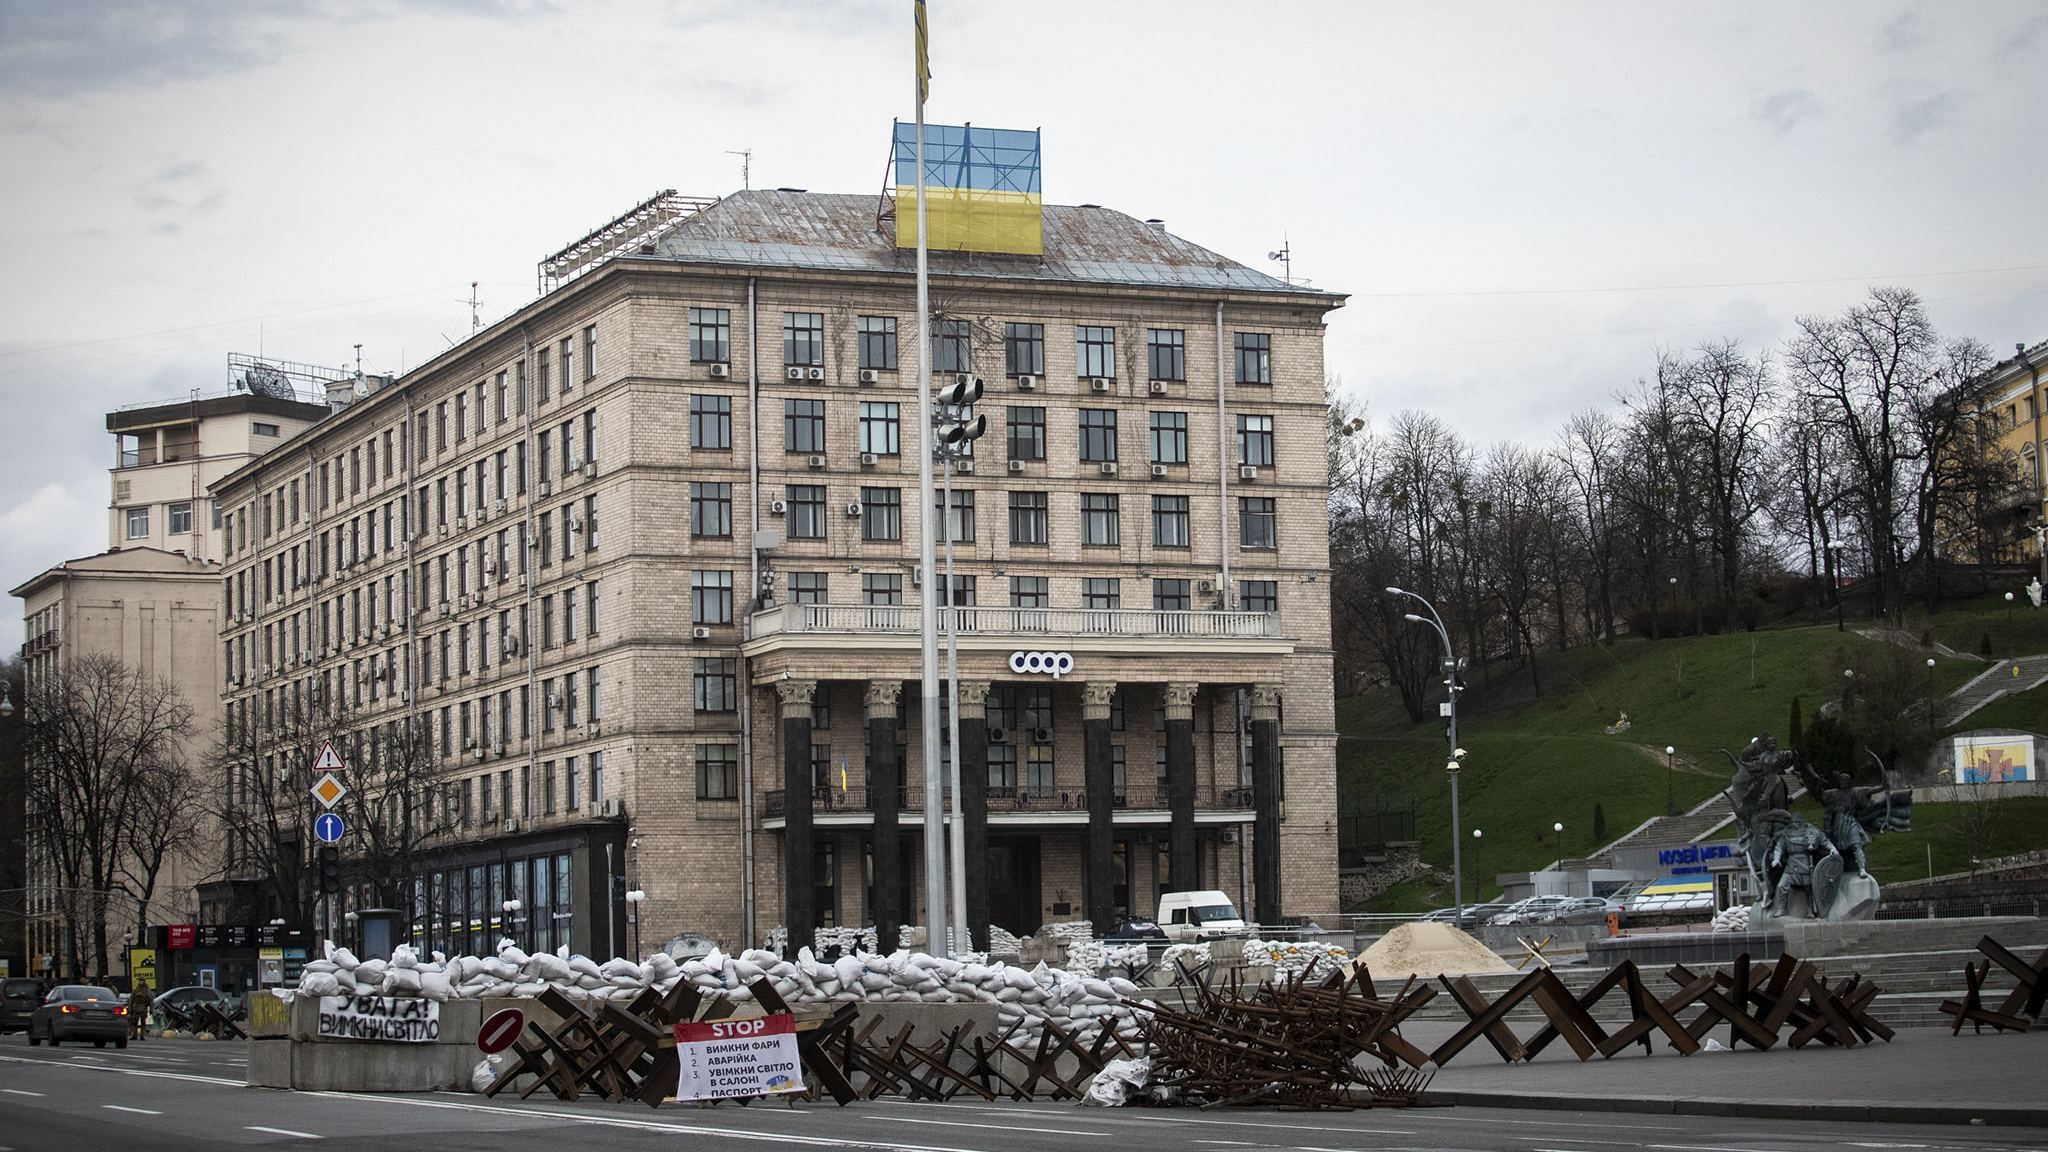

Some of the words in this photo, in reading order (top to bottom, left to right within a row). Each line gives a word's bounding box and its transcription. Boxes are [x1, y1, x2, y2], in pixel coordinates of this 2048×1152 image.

[1009, 651, 1073, 679] coop
[1659, 845, 1698, 865] МУЗЕЙ
[338, 996, 429, 1018] УВАГА!
[712, 1019, 765, 1037] STOP
[706, 1043, 750, 1055] ВИМКНИ
[752, 1040, 780, 1050] ФАРИ
[708, 1053, 757, 1065] АВАРІЙКА
[709, 1065, 755, 1077] УВІМКНИ
[757, 1062, 794, 1073] СВІТЛО
[711, 1079, 717, 1087] В
[719, 1076, 759, 1086] САЛОНІ
[711, 1087, 762, 1097] ПАСПОРТ
